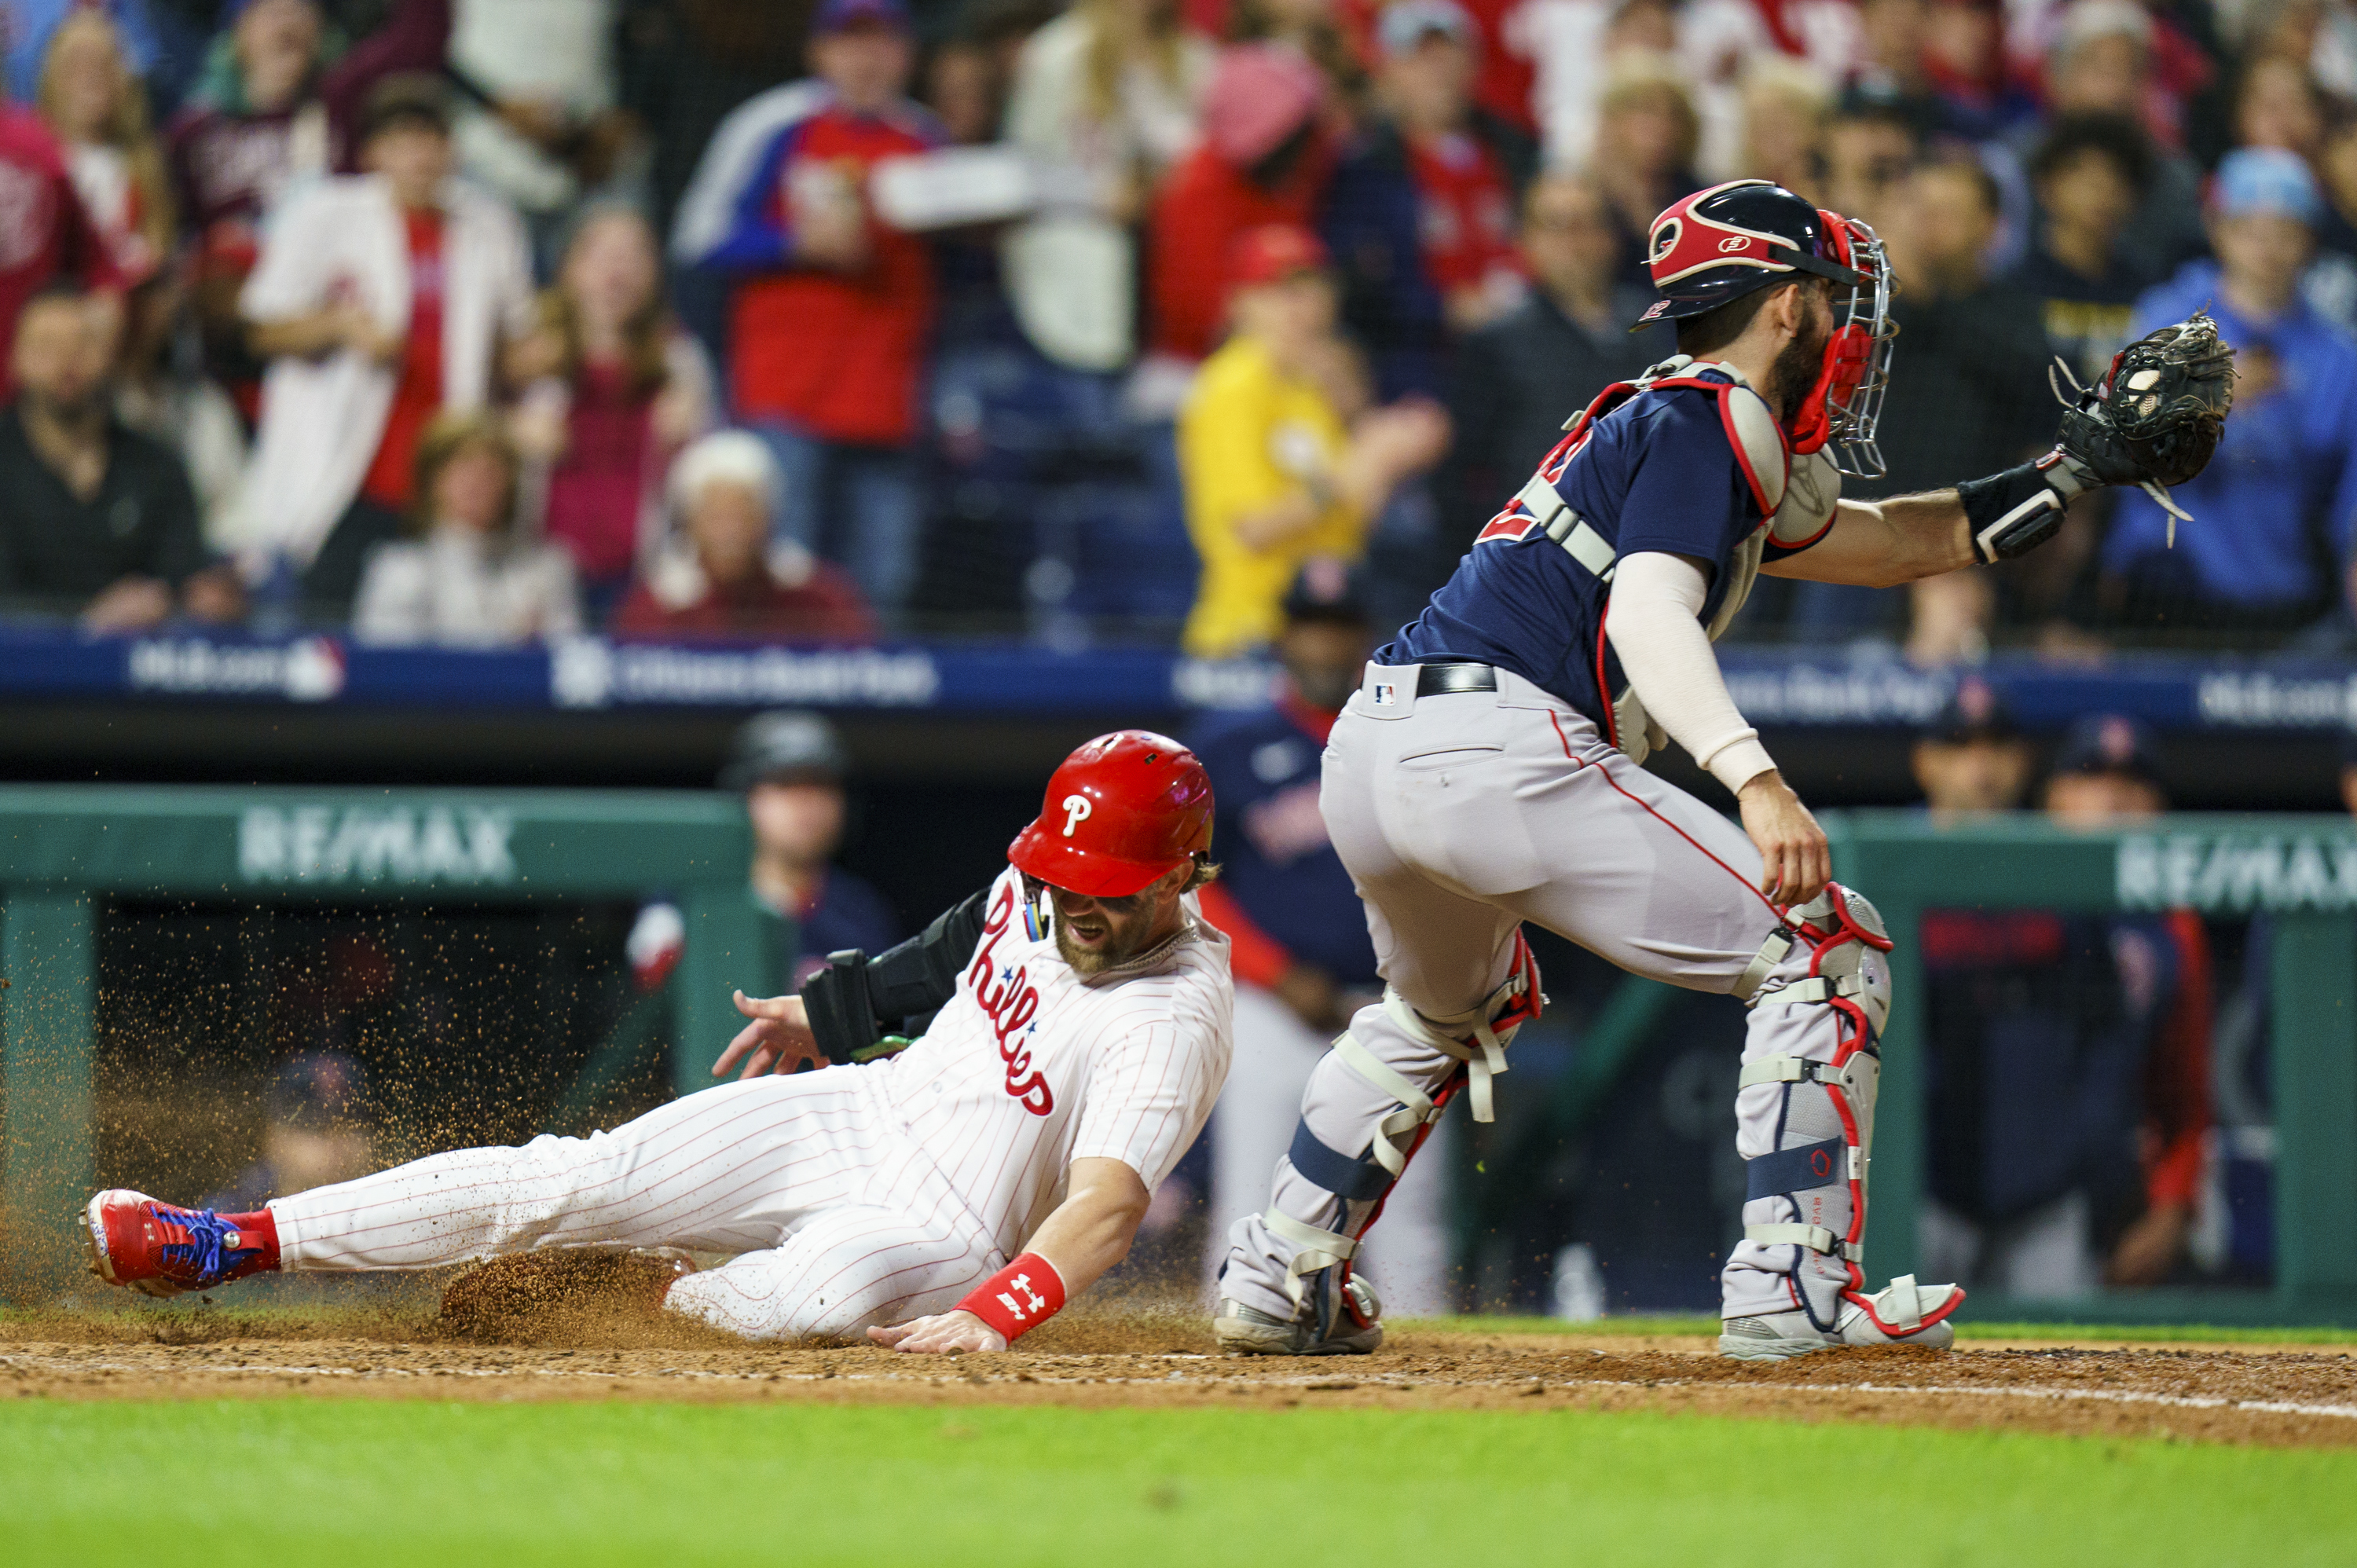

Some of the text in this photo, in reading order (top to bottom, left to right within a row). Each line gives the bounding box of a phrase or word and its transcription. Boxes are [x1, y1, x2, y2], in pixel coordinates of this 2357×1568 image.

[237, 803, 519, 885] RE/MAX
[1062, 794, 1092, 837] P
[2115, 834, 2357, 913] RE/MA
[968, 880, 1054, 1116] Phillies
